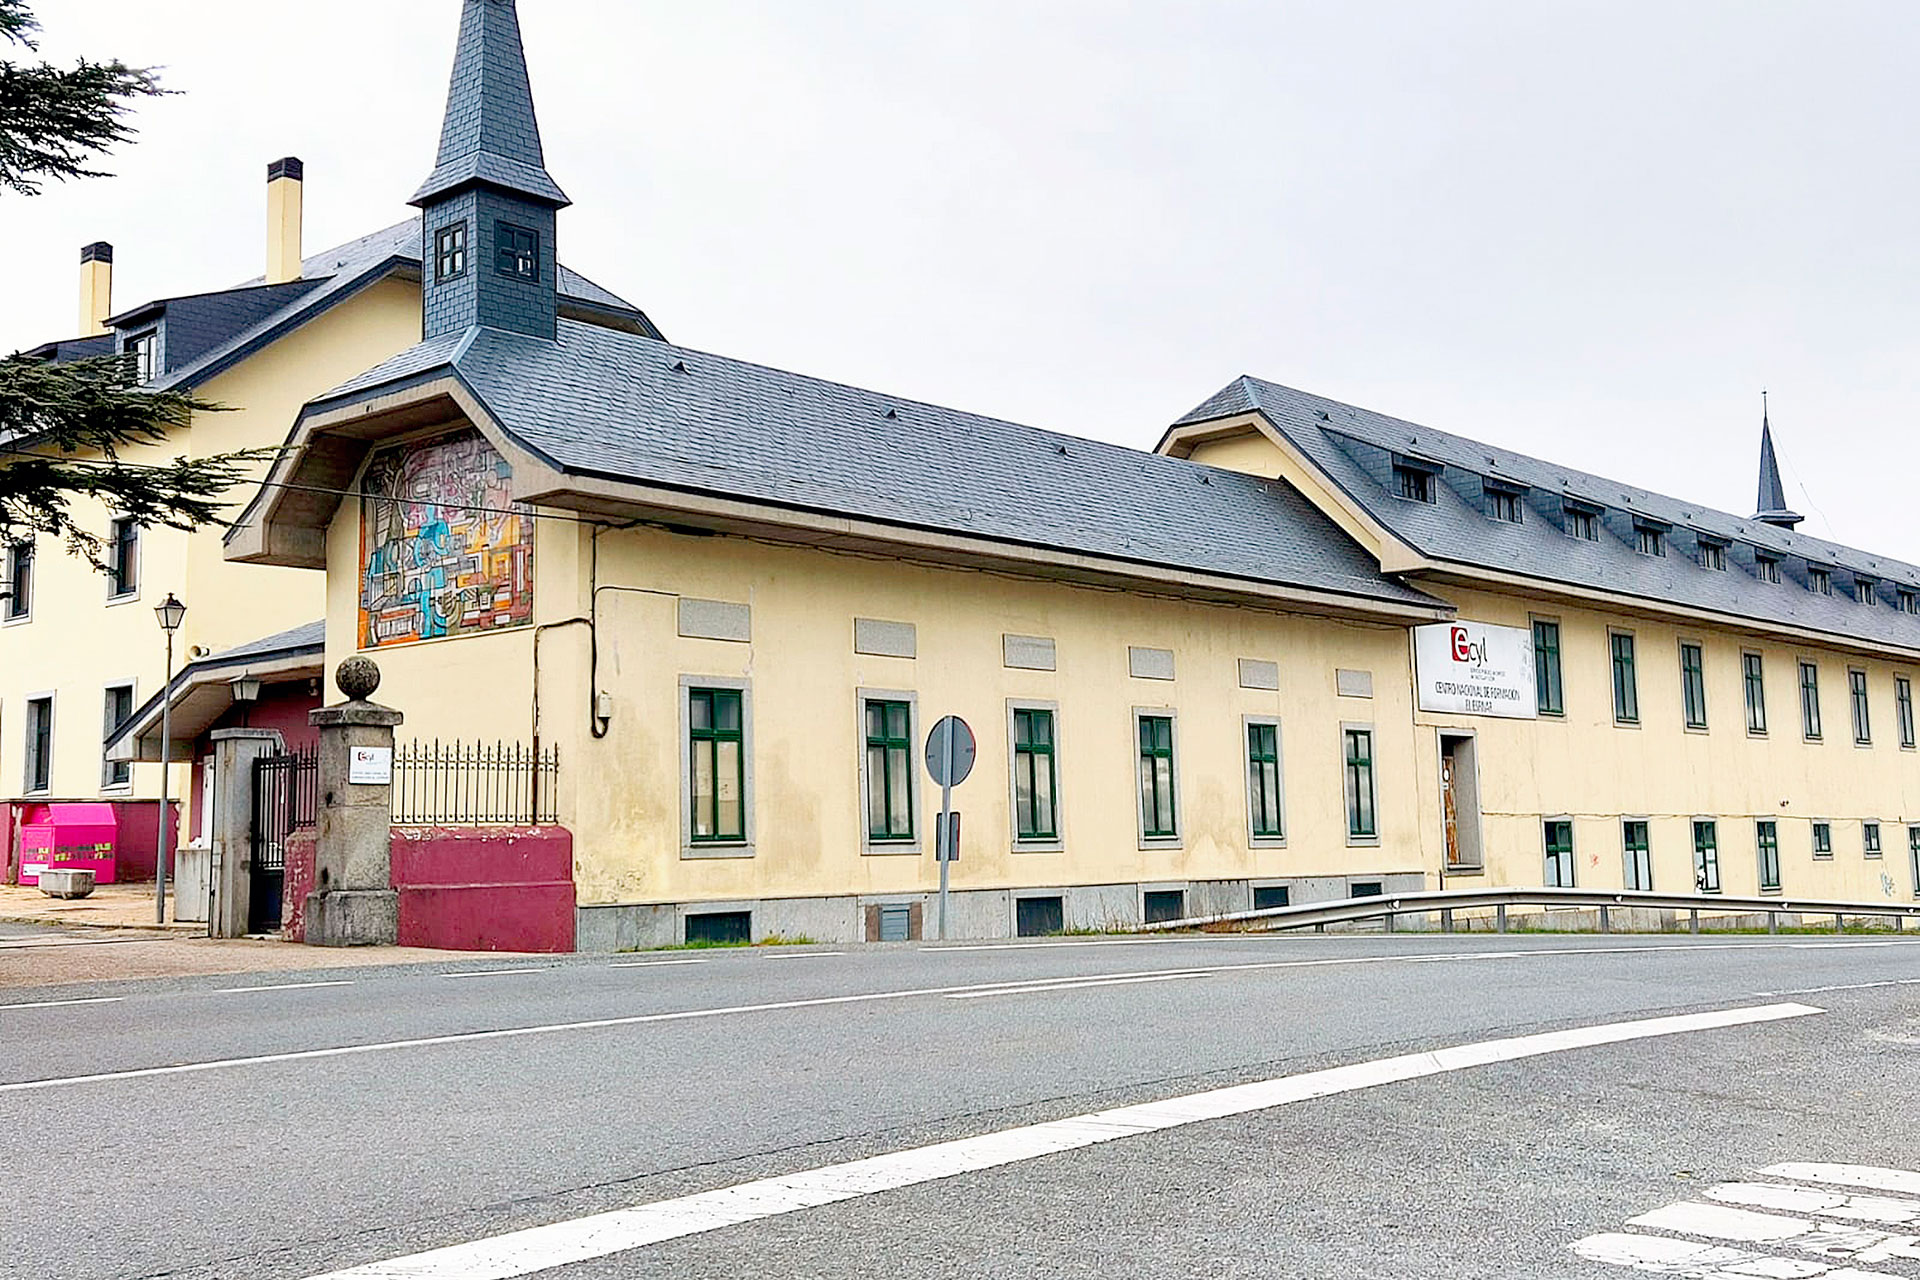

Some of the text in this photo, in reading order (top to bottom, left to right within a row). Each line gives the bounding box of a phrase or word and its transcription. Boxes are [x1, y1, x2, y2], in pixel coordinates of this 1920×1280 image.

[1435, 681, 1456, 695] CENTRO
[1457, 683, 1483, 698] NACIONAL
[1483, 686, 1490, 699] DE
[1465, 699, 1471, 712] EL
